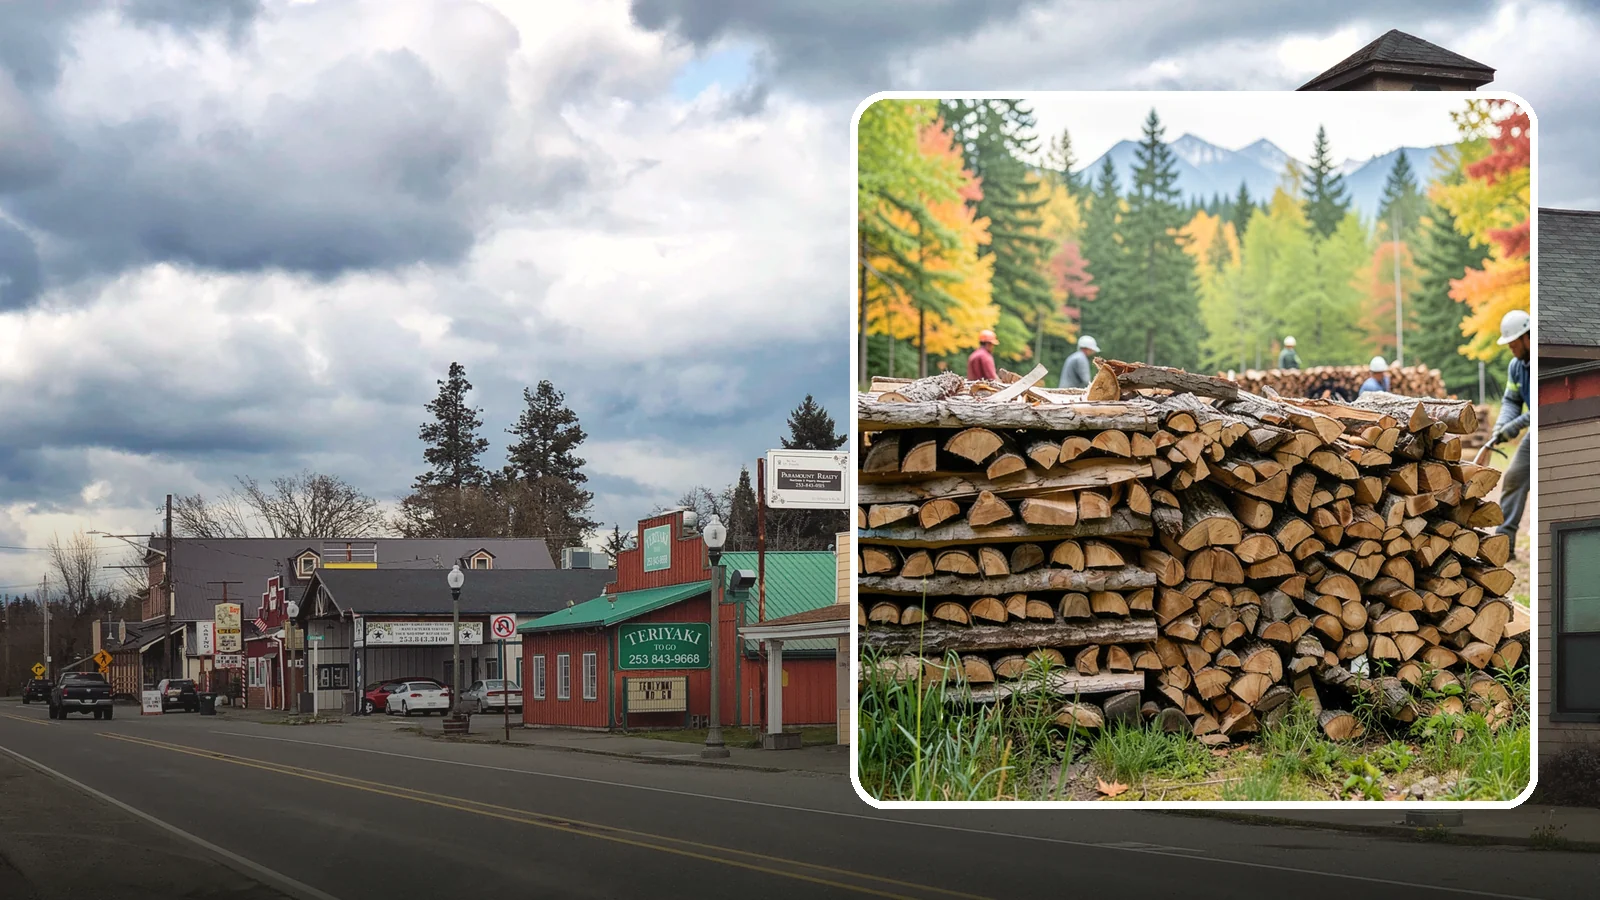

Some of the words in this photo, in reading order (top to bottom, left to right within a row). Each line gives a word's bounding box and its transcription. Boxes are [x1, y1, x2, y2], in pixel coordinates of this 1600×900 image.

[781, 471, 815, 479] PARAMOUNT
[817, 472, 839, 480] REALTY
[624, 627, 702, 646] TERIYAKI
[629, 654, 648, 665] 253
[651, 653, 700, 664] 843-9668
[639, 681, 672, 691] TERIYAKI
